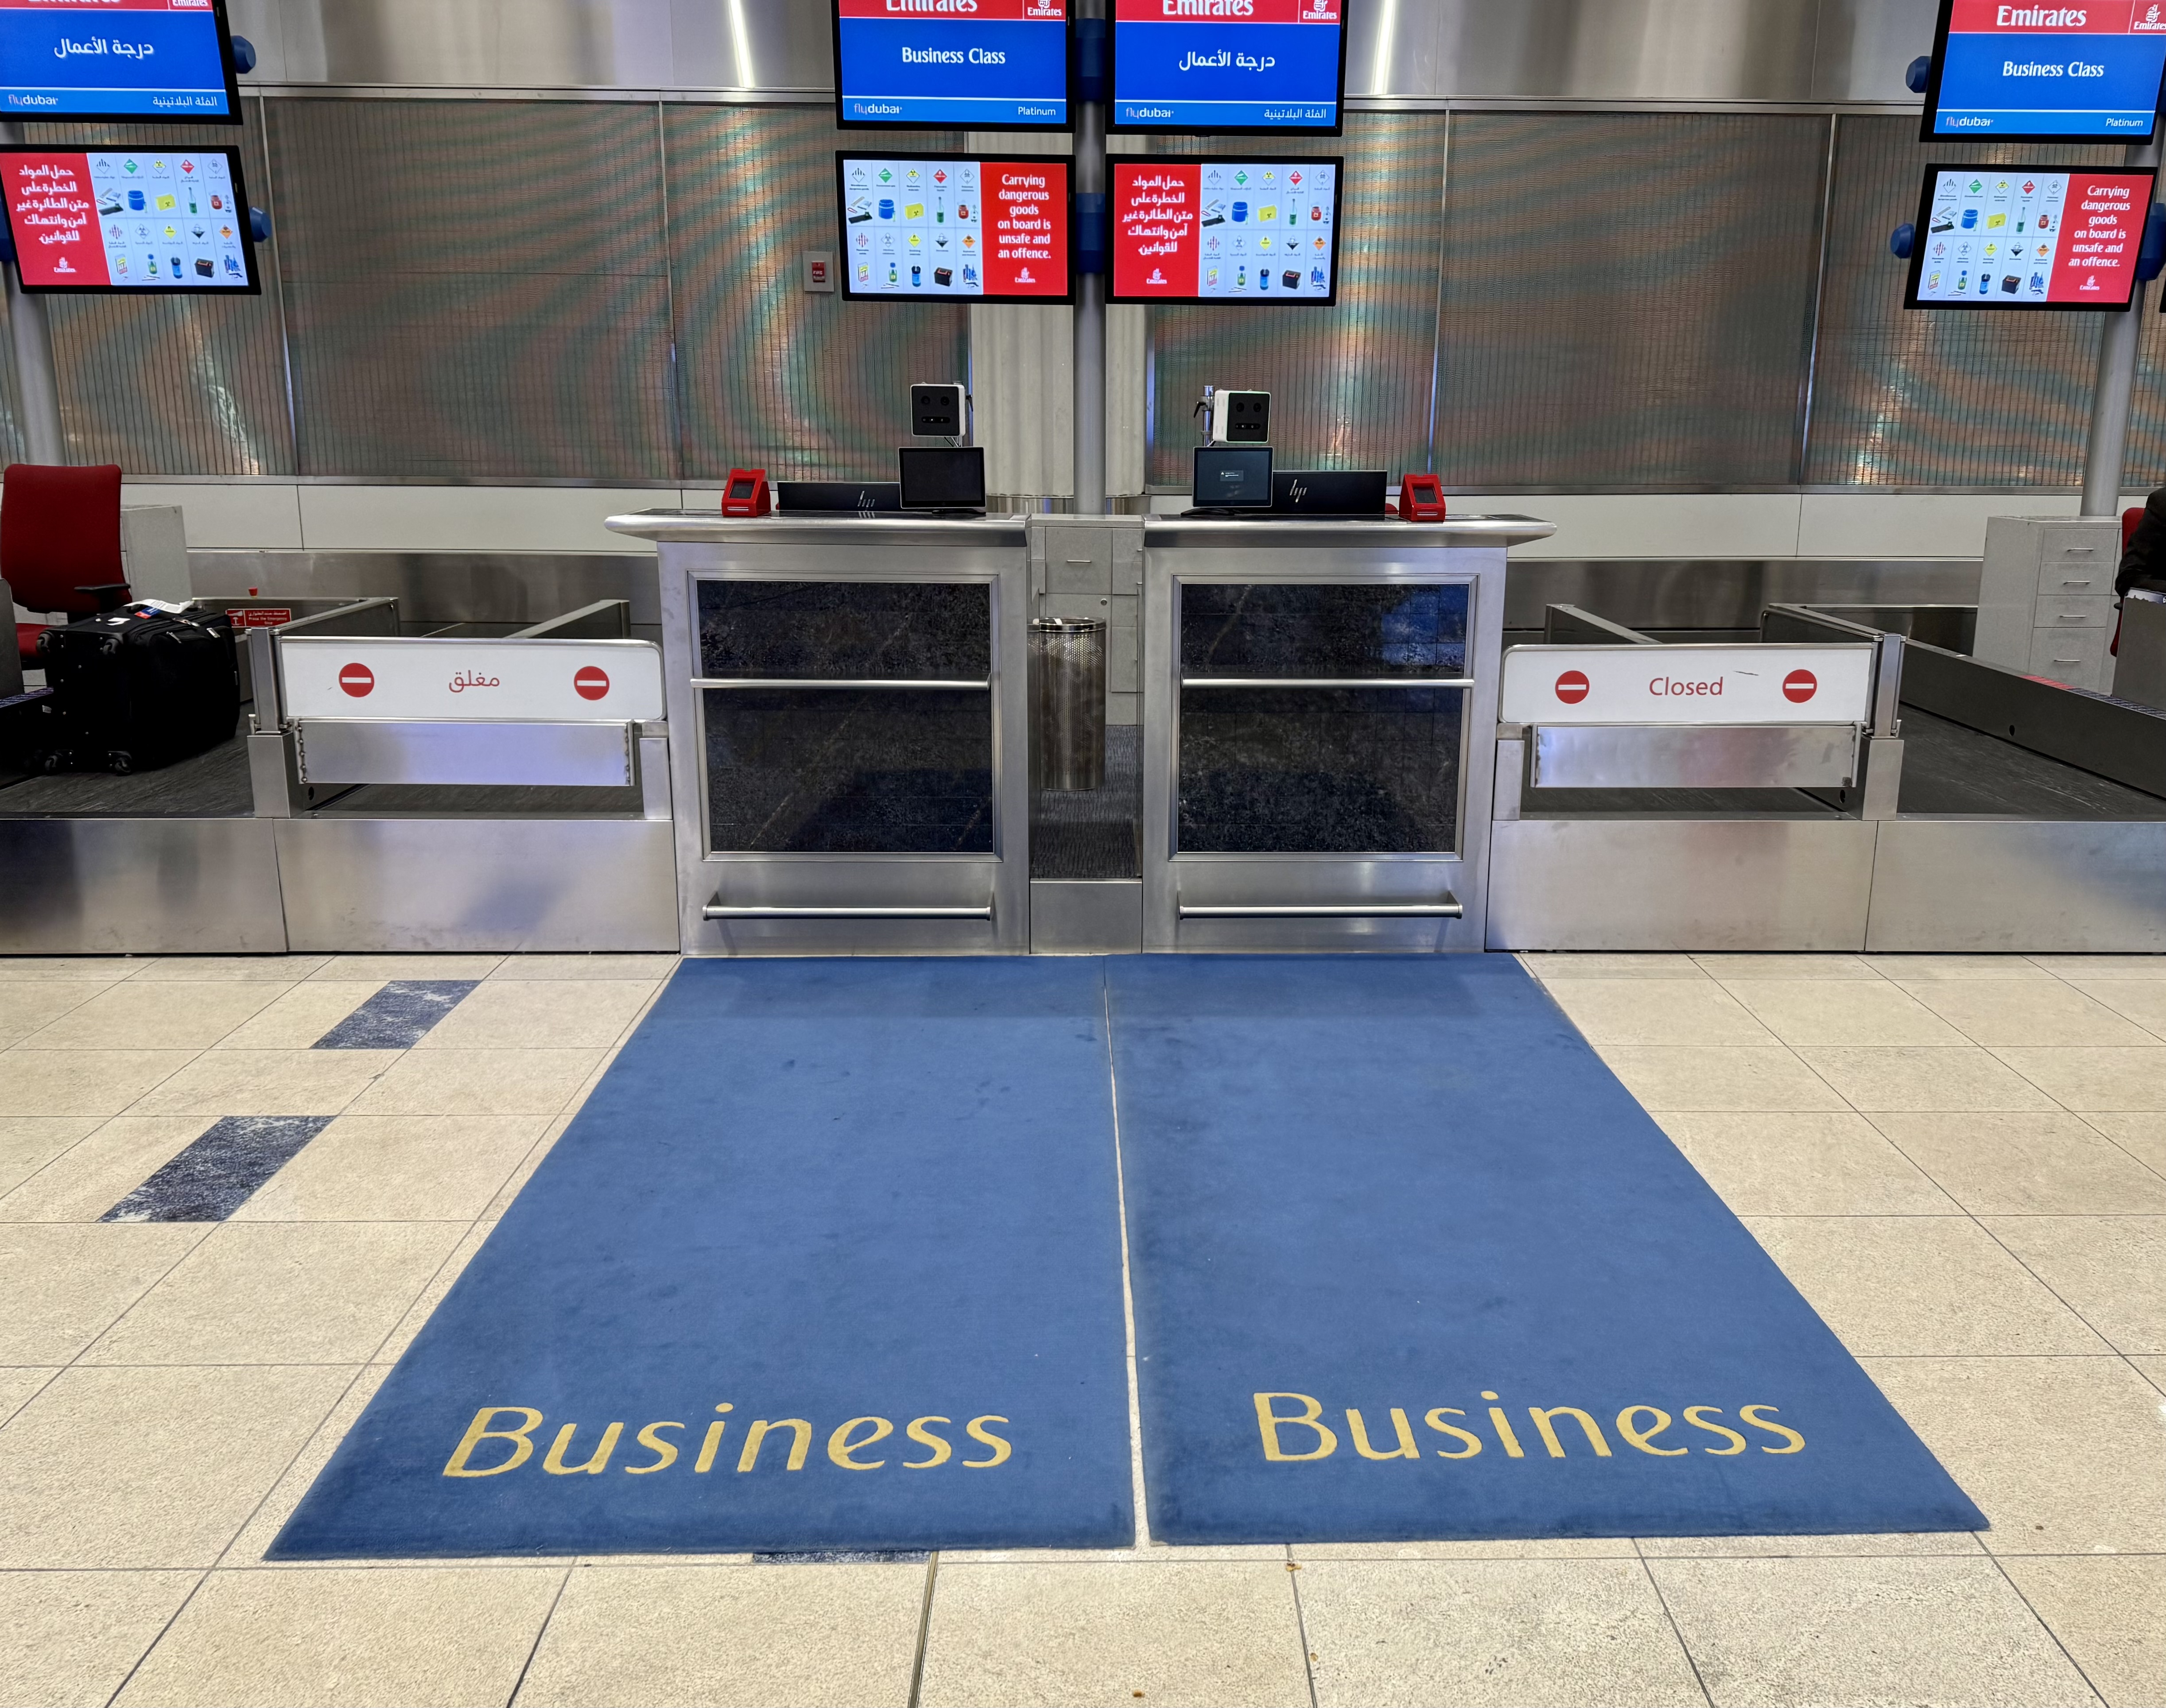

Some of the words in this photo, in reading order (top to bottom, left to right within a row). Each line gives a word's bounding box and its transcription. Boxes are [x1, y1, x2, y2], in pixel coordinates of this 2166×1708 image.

[1028, 5, 1062, 16] Emirates
[1303, 9, 1337, 19] Emirates
[1997, 5, 2086, 26] Emirates
[54, 37, 108, 58] الأعمال
[113, 40, 153, 59] درجة
[902, 47, 963, 63] Business
[969, 48, 1005, 64] Class
[1179, 50, 1231, 70] الأعمال
[1236, 53, 1275, 71] درجة
[2003, 62, 2063, 76] Business
[2068, 62, 2104, 77] Class
[153, 97, 192, 107] البلاتينية
[195, 97, 217, 106] الفئة
[1018, 107, 1056, 115] Platinum
[1264, 109, 1302, 120] البلاتينية
[1305, 109, 1326, 118] الفئة
[19, 165, 49, 178] المواد
[50, 165, 74, 179] حمل
[1002, 174, 1045, 188] Carrying
[1132, 175, 1161, 190] المواد
[1162, 176, 1184, 190] حمل
[21, 181, 42, 195] على
[43, 181, 77, 195] الخطرة
[2088, 186, 2130, 198] Carrying
[999, 189, 1049, 202] dangerous
[1131, 192, 1151, 206] على
[1152, 192, 1184, 206] الخطرة
[16, 200, 32, 211] غير
[69, 200, 89, 212] متن
[1010, 204, 1039, 217] goods
[2081, 200, 2130, 213] dangerous
[24, 214, 68, 228] وانتهاك
[68, 212, 86, 228] آمن
[1122, 211, 1138, 222] غير
[1174, 211, 1193, 223] متن
[2089, 215, 2117, 227] goods
[1013, 218, 1040, 229] board
[1044, 219, 1051, 229] is
[1128, 225, 1168, 239] وانتهاك
[1169, 222, 1188, 239] آمن
[2089, 229, 2117, 238] board
[2118, 229, 2126, 239] is
[999, 233, 1030, 244] unsafe
[1033, 233, 1050, 244] and
[1012, 248, 1051, 258] offence.
[2073, 243, 2104, 252] unsafe
[2105, 243, 2123, 252] and
[2082, 257, 2119, 267] offence.
[448, 670, 500, 693] مغلق
[1649, 677, 1723, 696] Closed
[1254, 1392, 1805, 1461] Business
[444, 1404, 1011, 1477] Business
